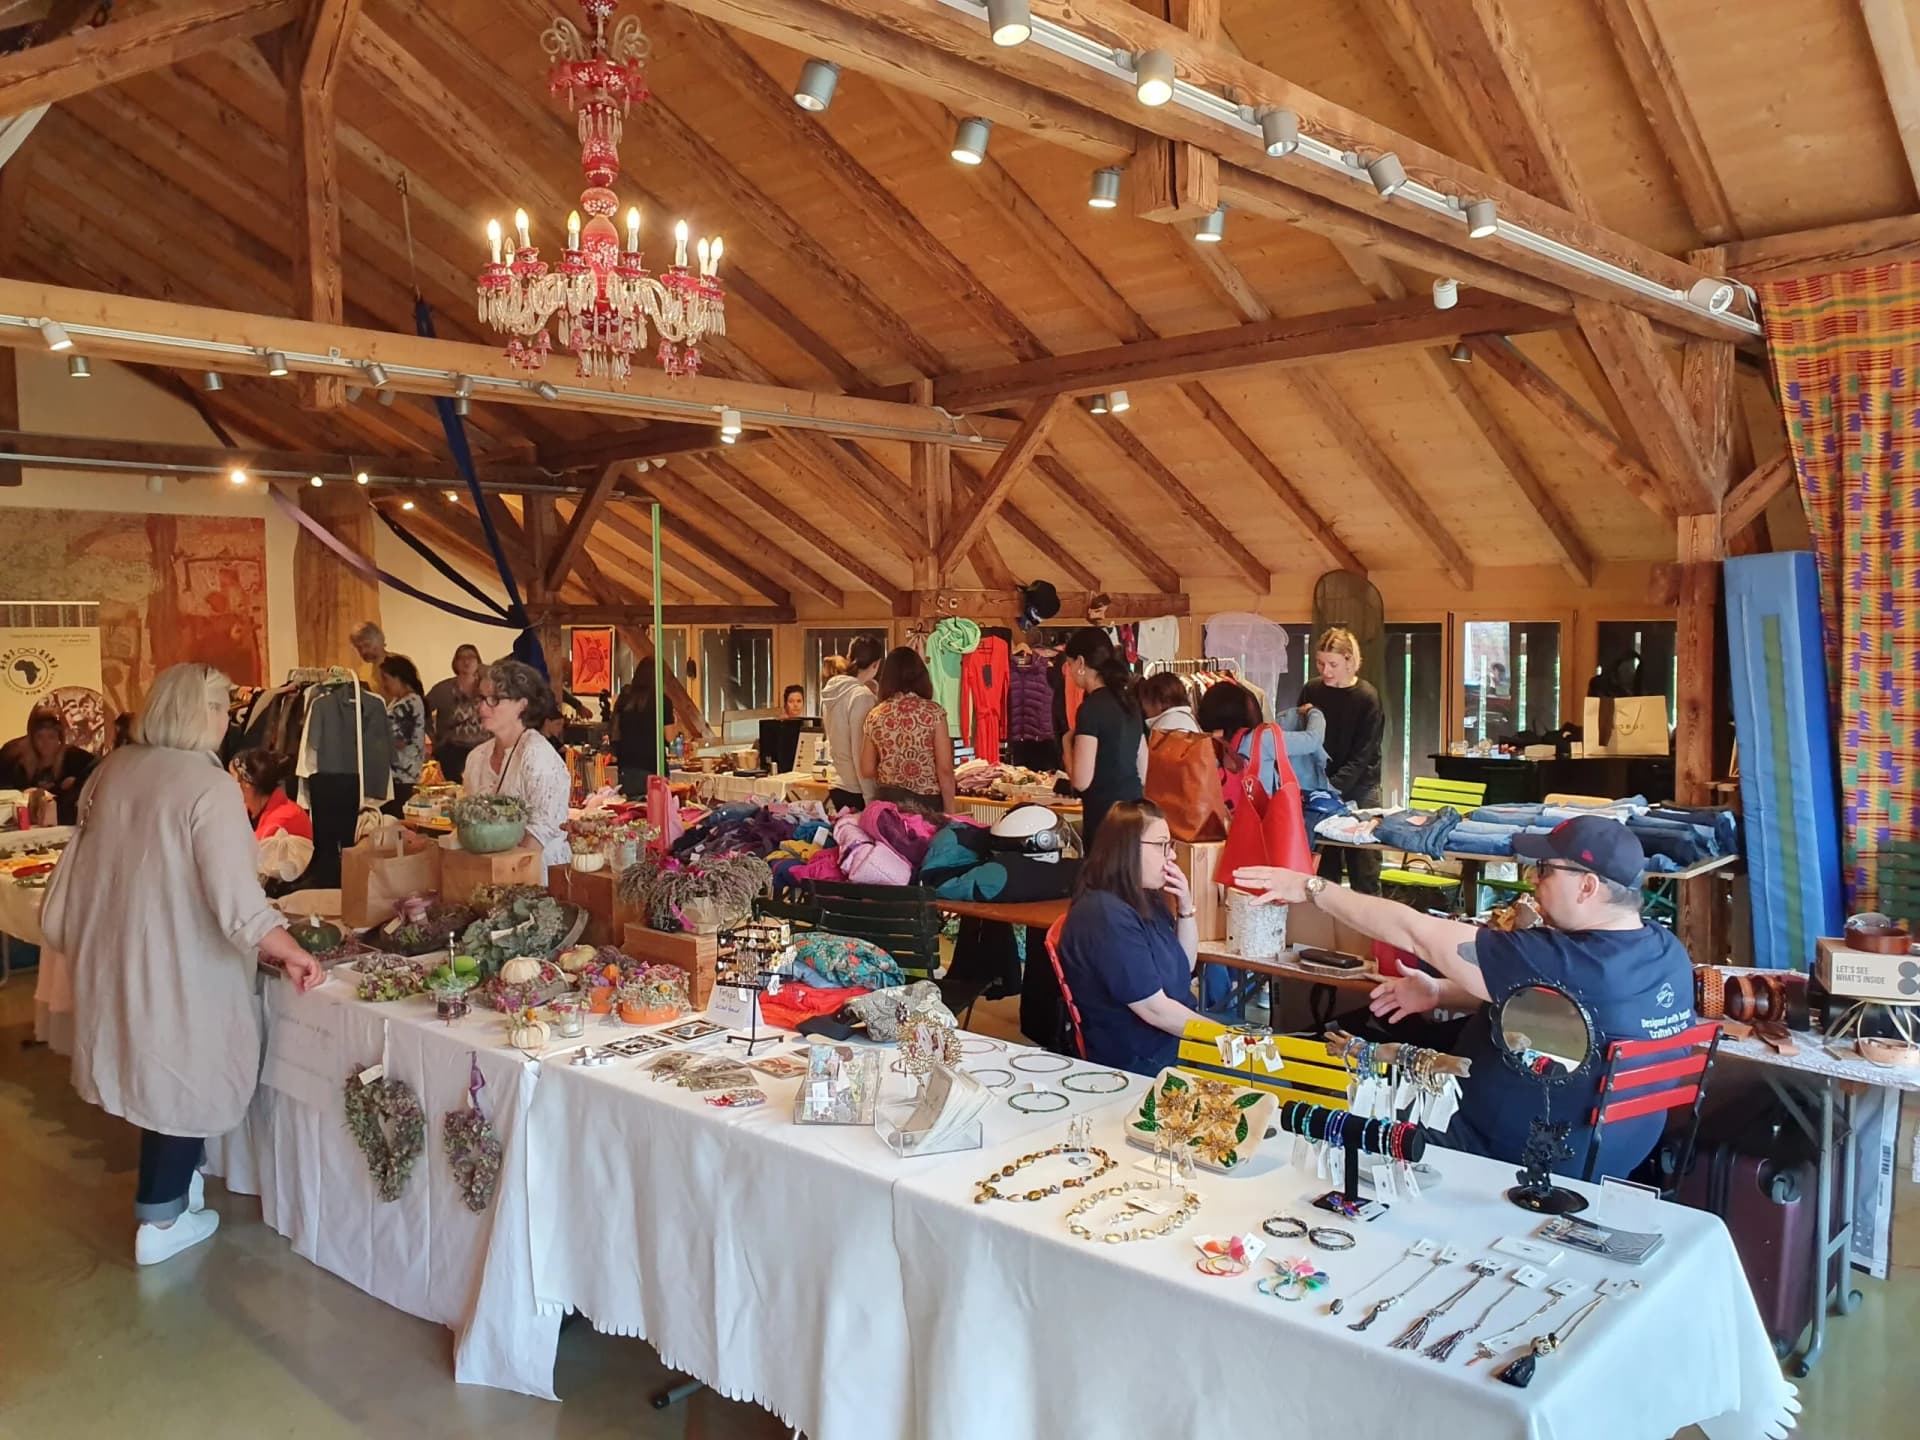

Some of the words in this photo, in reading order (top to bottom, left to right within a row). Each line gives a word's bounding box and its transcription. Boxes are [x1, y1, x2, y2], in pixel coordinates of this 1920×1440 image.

[1836, 965, 1854, 974] LET'S
[1856, 966, 1868, 975] SEE
[1836, 974, 1861, 983] WHAT'S
[1863, 976, 1886, 984] INSIDE
[1641, 1015, 1667, 1029] Designed
